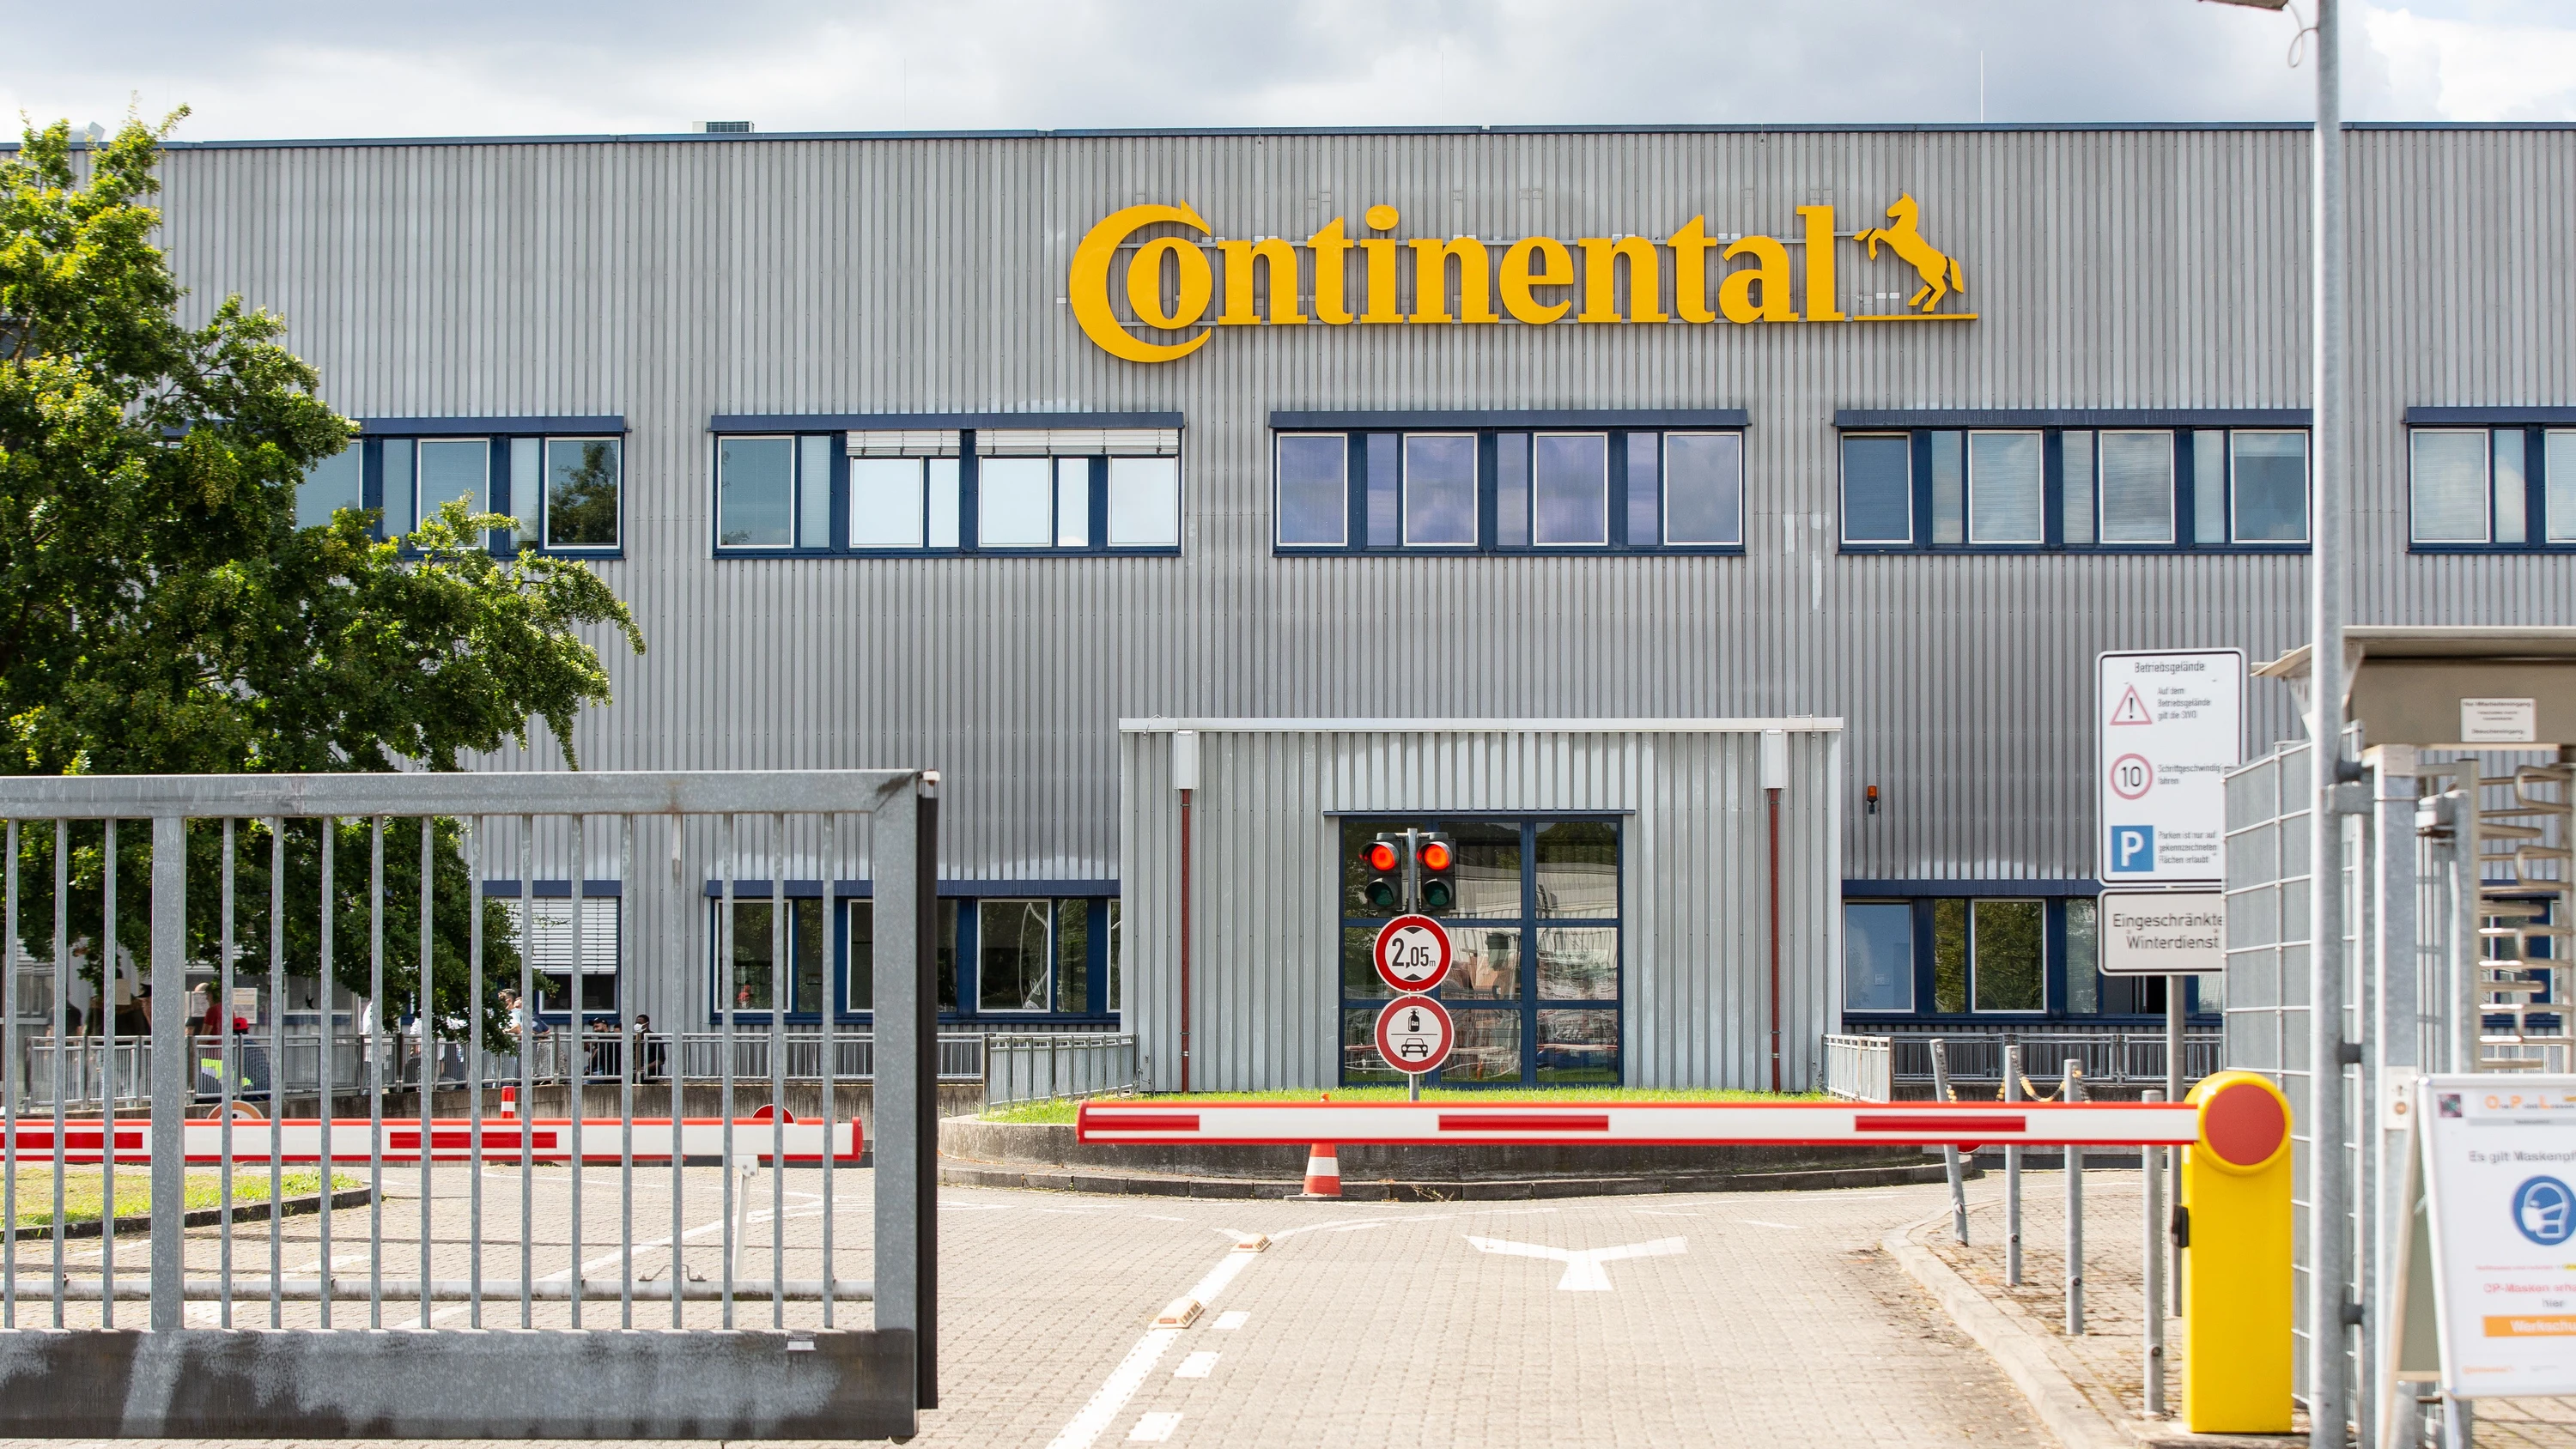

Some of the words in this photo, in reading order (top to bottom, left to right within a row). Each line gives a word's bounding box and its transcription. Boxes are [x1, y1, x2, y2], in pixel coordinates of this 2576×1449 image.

[1069, 199, 1845, 362] Continental
[2135, 661, 2205, 675] Betriebsgelände
[2157, 698, 2210, 708] Betriebsgelände
[2157, 712, 2168, 721] gilt
[2170, 711, 2179, 719] die
[2181, 710, 2196, 719] StVO
[2157, 762, 2222, 774] Schrittgeschwindig
[2121, 766, 2141, 787] 10
[2157, 777, 2179, 785] fahren
[2158, 830, 2181, 840] Parken
[2205, 829, 2216, 839] auf
[2121, 831, 2144, 867] P
[2158, 844, 2217, 853] gekennzeichneten
[2158, 855, 2184, 864] Flächen
[2185, 855, 2209, 864] erlaubt
[2113, 912, 2222, 931] Eingeschränkte
[2127, 935, 2219, 949] Winterdienst
[2468, 1150, 2485, 1162] Es
[2489, 1150, 2509, 1165] gilt
[2513, 1149, 2576, 1166] Maskenpf
[2542, 1299, 2564, 1307] hier
[2509, 1319, 2576, 1333] Werkschu
